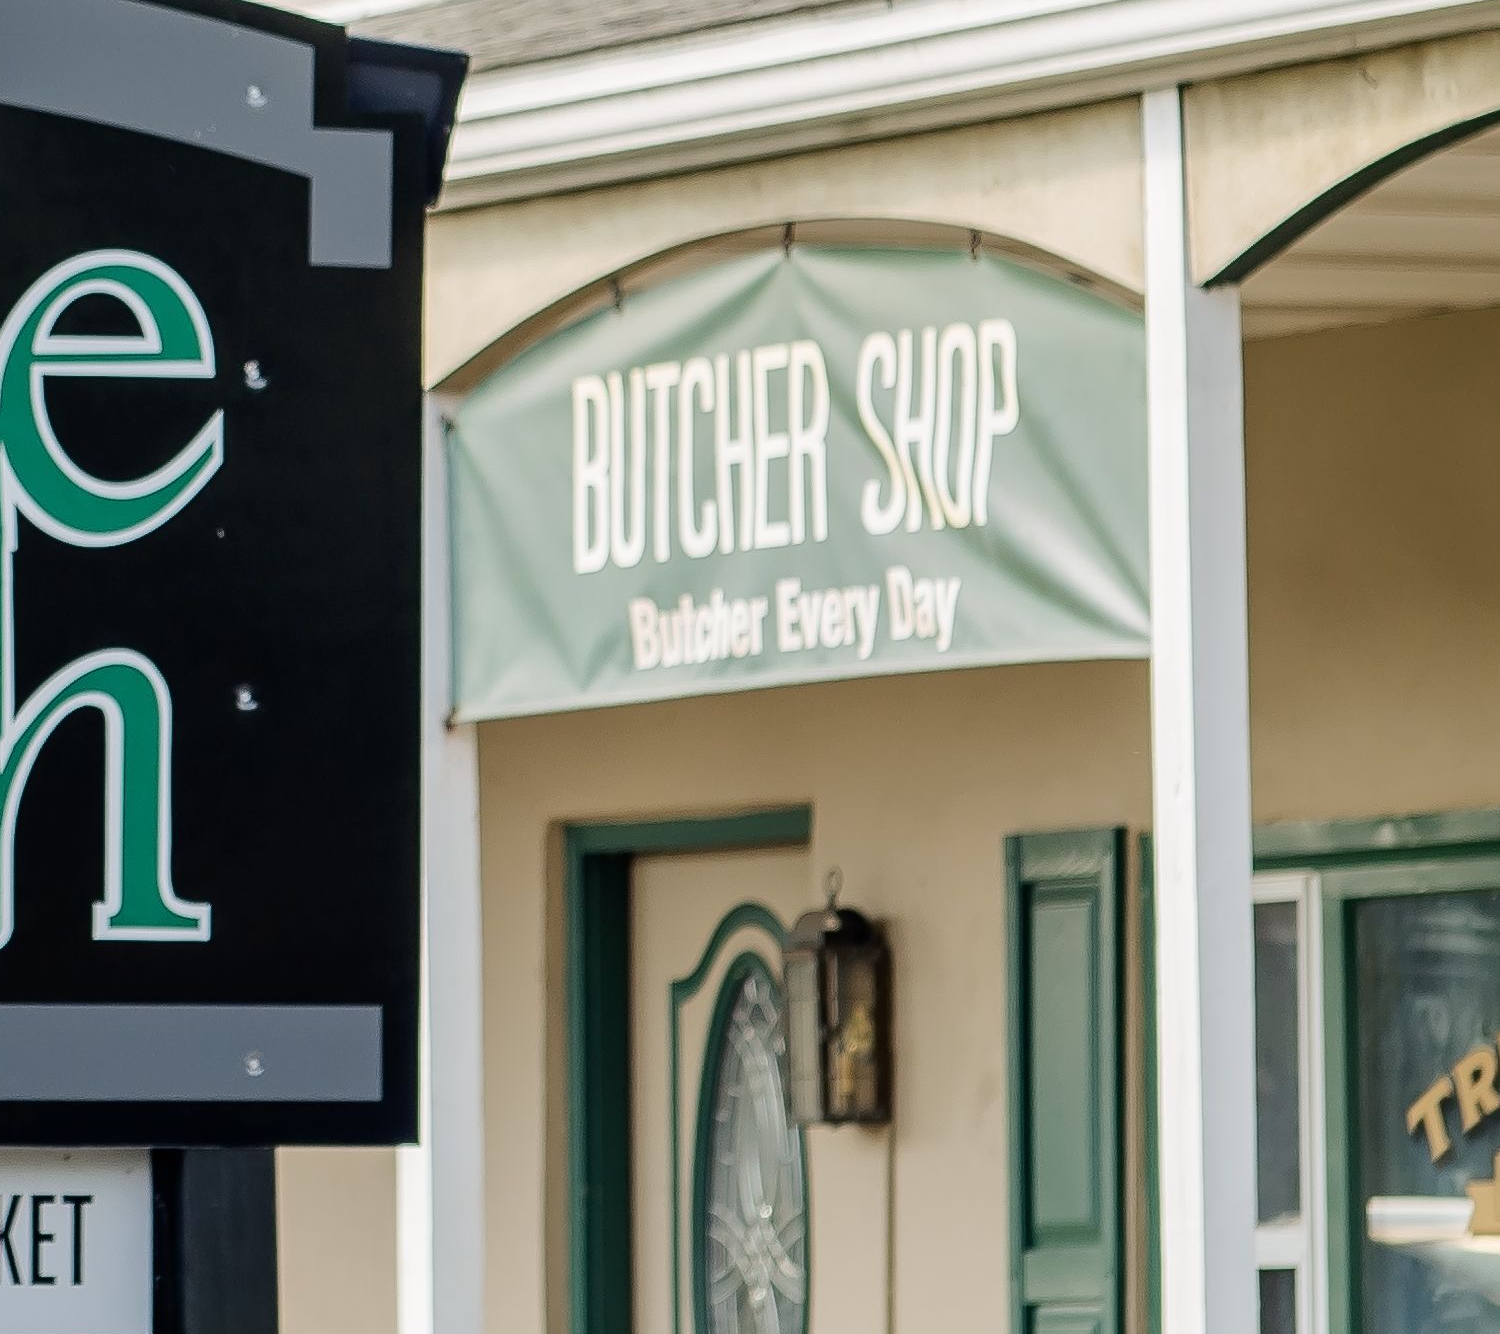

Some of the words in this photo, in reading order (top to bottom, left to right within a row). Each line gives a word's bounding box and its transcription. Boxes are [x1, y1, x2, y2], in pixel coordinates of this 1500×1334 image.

[570, 339, 832, 576] BUTCHER
[856, 317, 1021, 536] SHOP
[627, 587, 769, 670] Butcher
[775, 577, 881, 660] Every
[886, 565, 962, 653] Day
